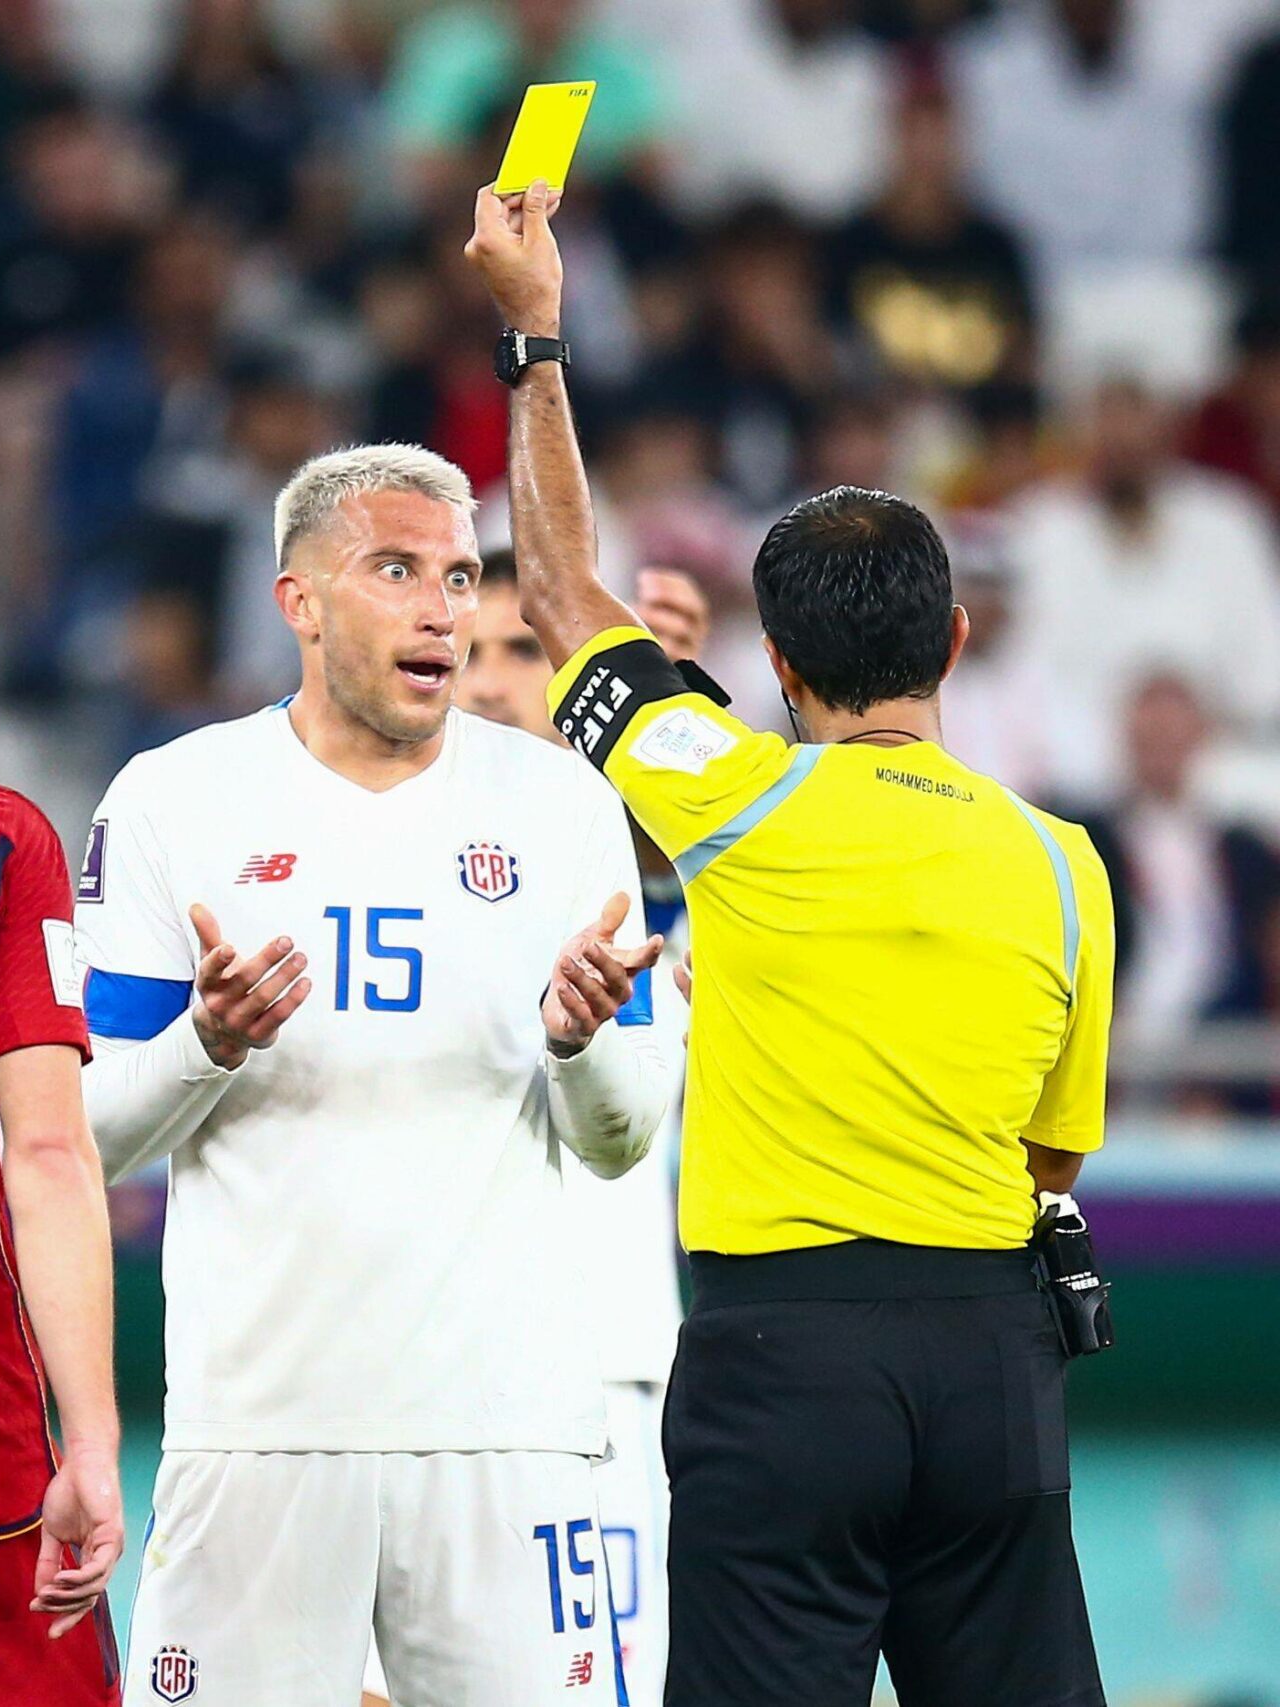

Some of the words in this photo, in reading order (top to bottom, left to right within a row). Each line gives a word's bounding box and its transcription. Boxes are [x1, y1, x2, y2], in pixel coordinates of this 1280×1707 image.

[569, 89, 588, 97] FIFA
[571, 666, 610, 718] TEAM
[876, 767, 934, 793] MOHAMMED
[470, 852, 507, 892] CR
[323, 906, 424, 1013] 15
[533, 1517, 595, 1634] 15
[160, 1656, 187, 1695] CR
